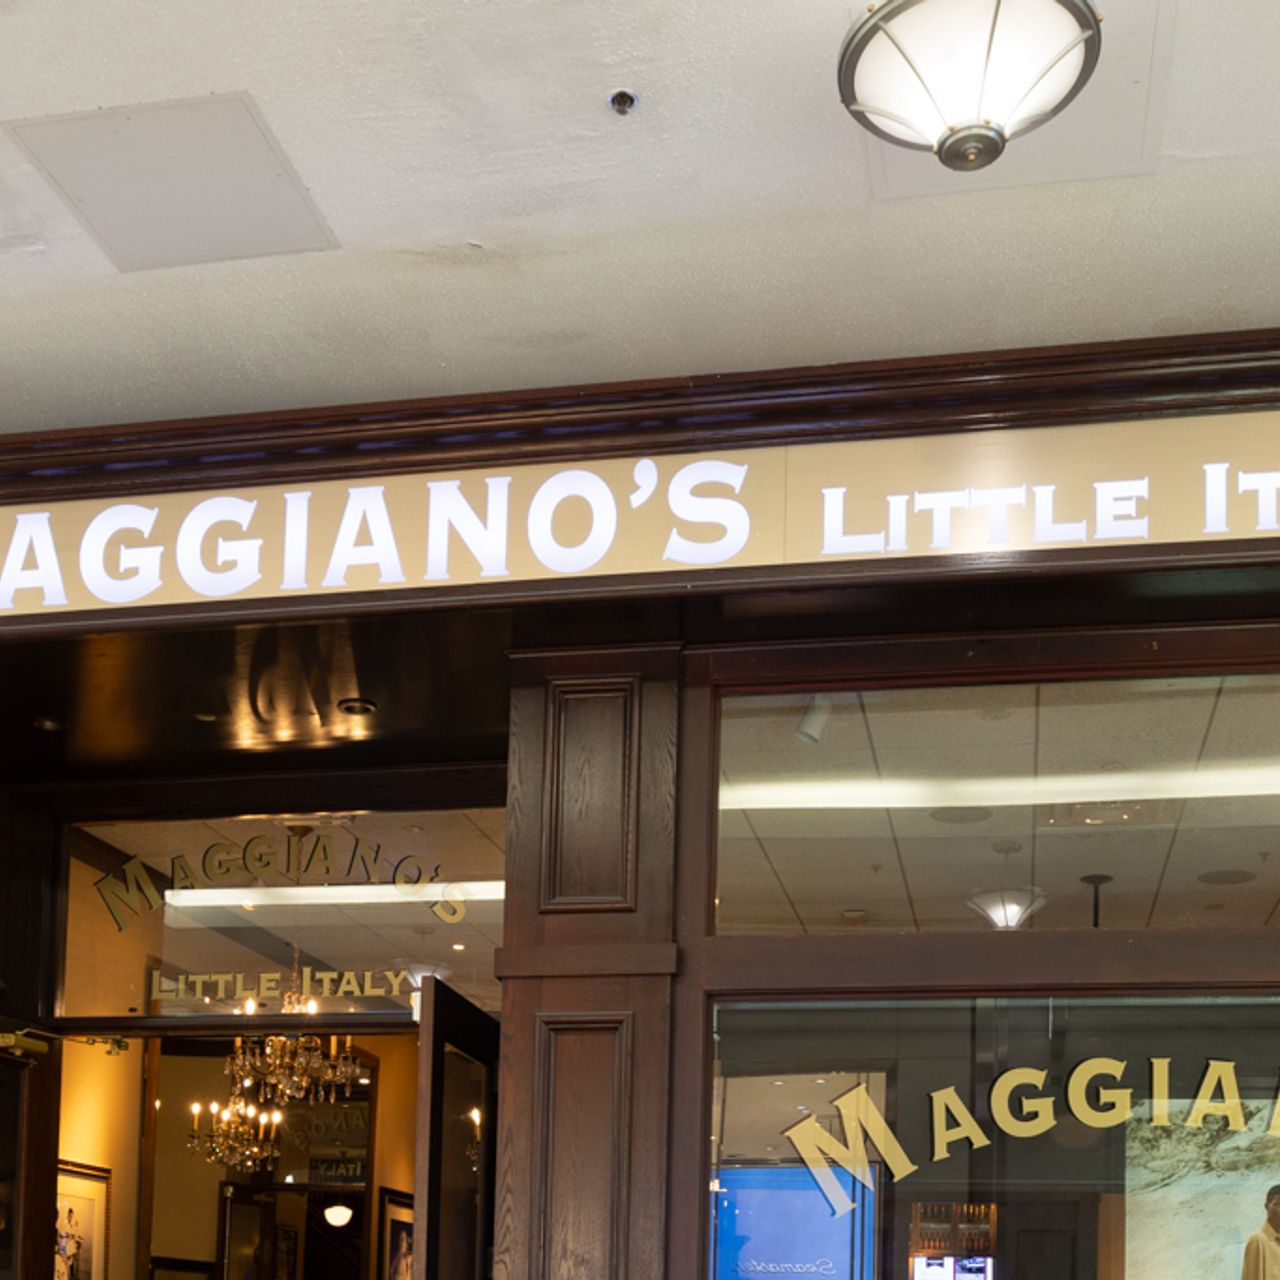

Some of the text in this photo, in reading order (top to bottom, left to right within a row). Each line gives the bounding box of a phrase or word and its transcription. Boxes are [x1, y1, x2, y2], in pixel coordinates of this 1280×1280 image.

[821, 475, 1149, 554] LITTLE
[93, 834, 469, 932] MAGGIANO'S
[151, 965, 408, 1000] LITTLE ITALY
